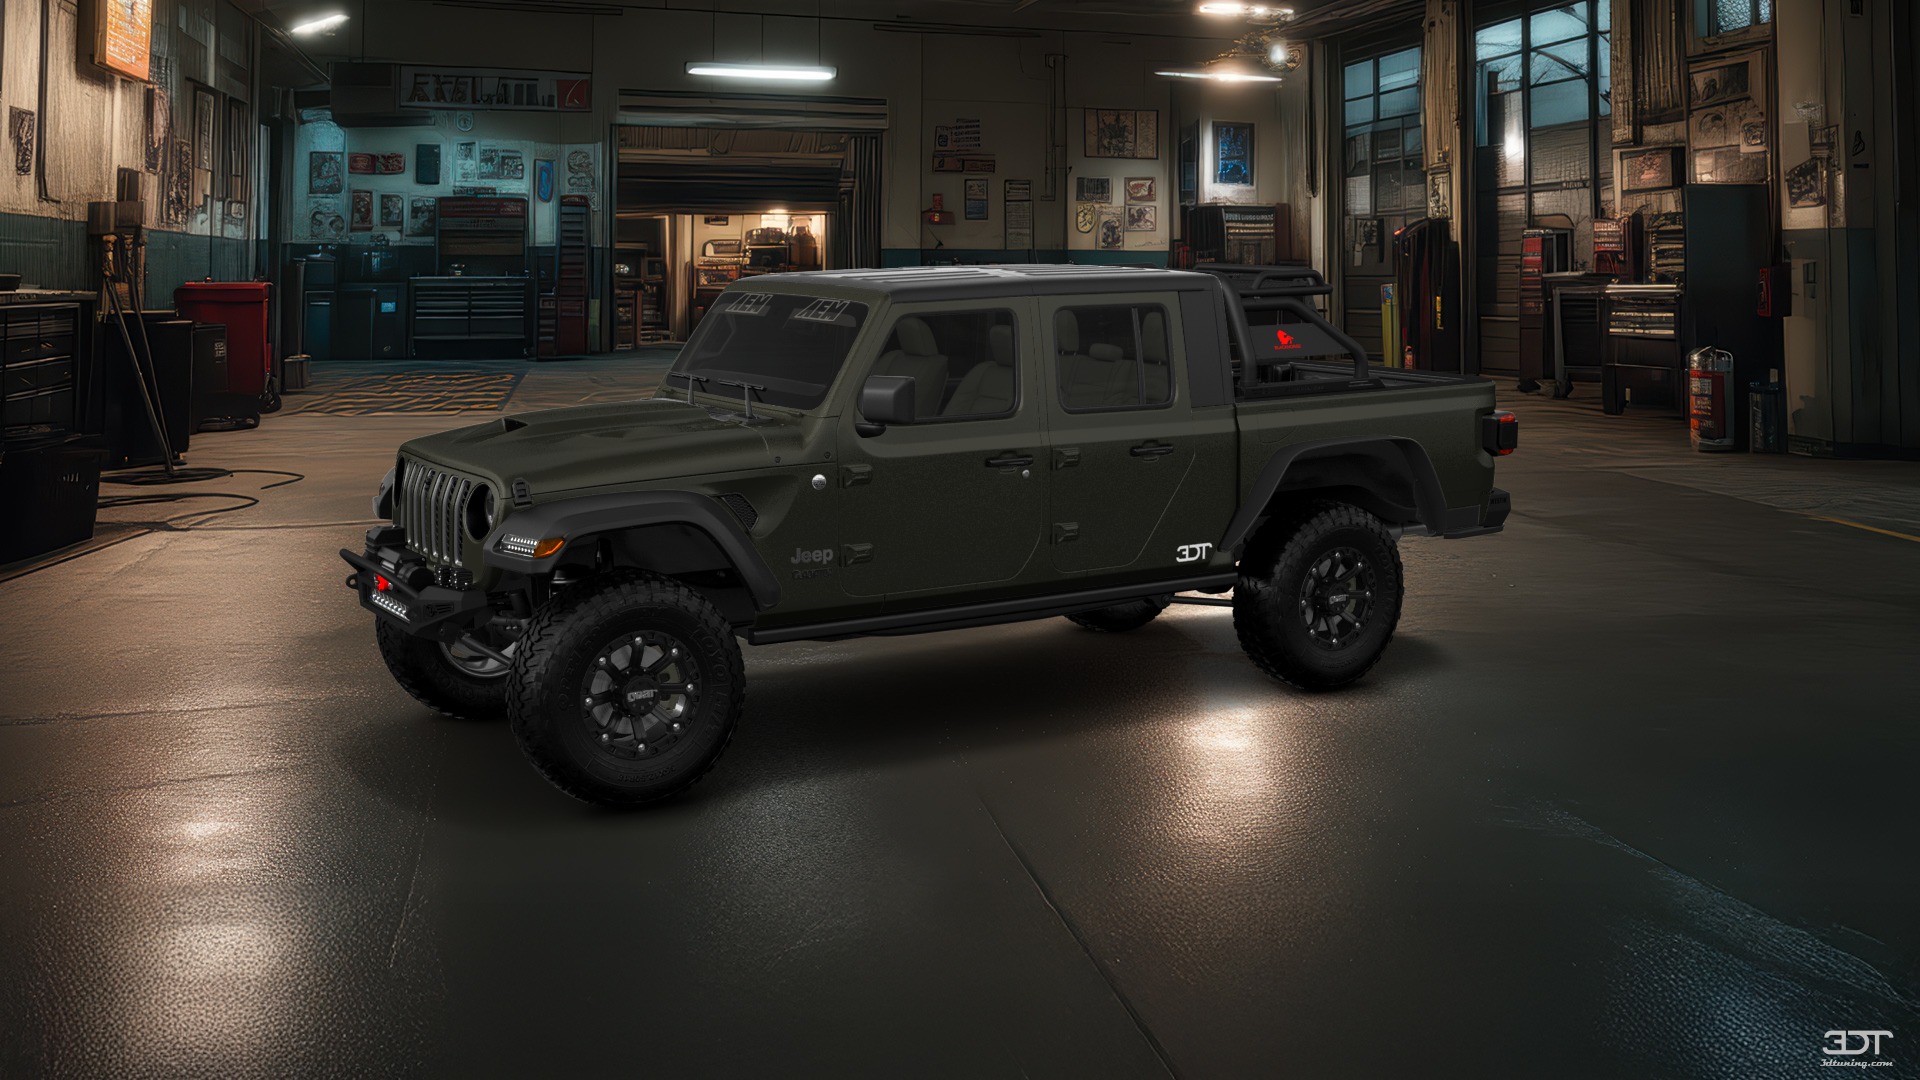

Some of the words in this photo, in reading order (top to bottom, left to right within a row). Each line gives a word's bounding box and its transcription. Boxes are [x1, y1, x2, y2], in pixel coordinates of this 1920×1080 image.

[725, 292, 774, 314] AEM
[794, 298, 851, 322] AEM
[791, 548, 834, 565] Jeep
[1176, 542, 1213, 563] 3DT
